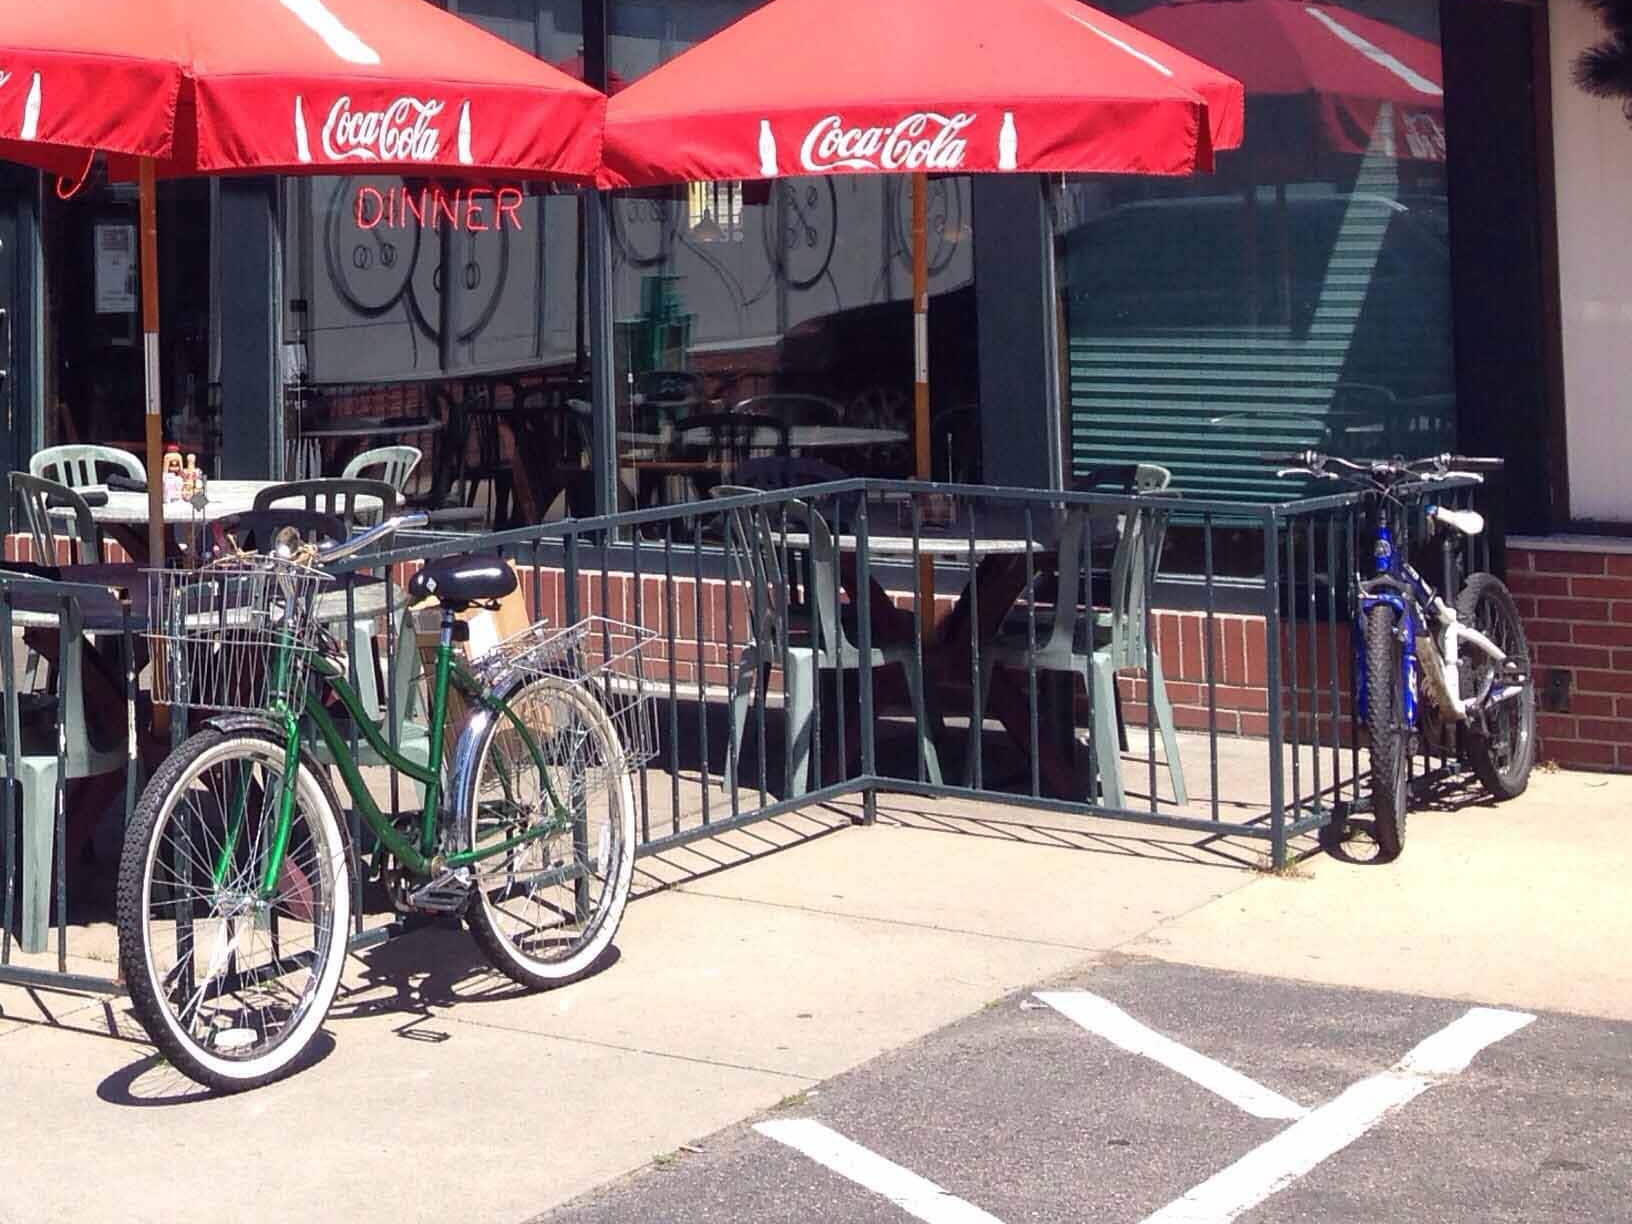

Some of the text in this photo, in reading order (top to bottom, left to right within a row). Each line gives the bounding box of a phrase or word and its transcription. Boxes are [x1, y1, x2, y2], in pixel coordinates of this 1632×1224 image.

[321, 96, 446, 161] Coca-Cola
[799, 112, 977, 171] Coca-Cola
[356, 187, 523, 231] DINNER
